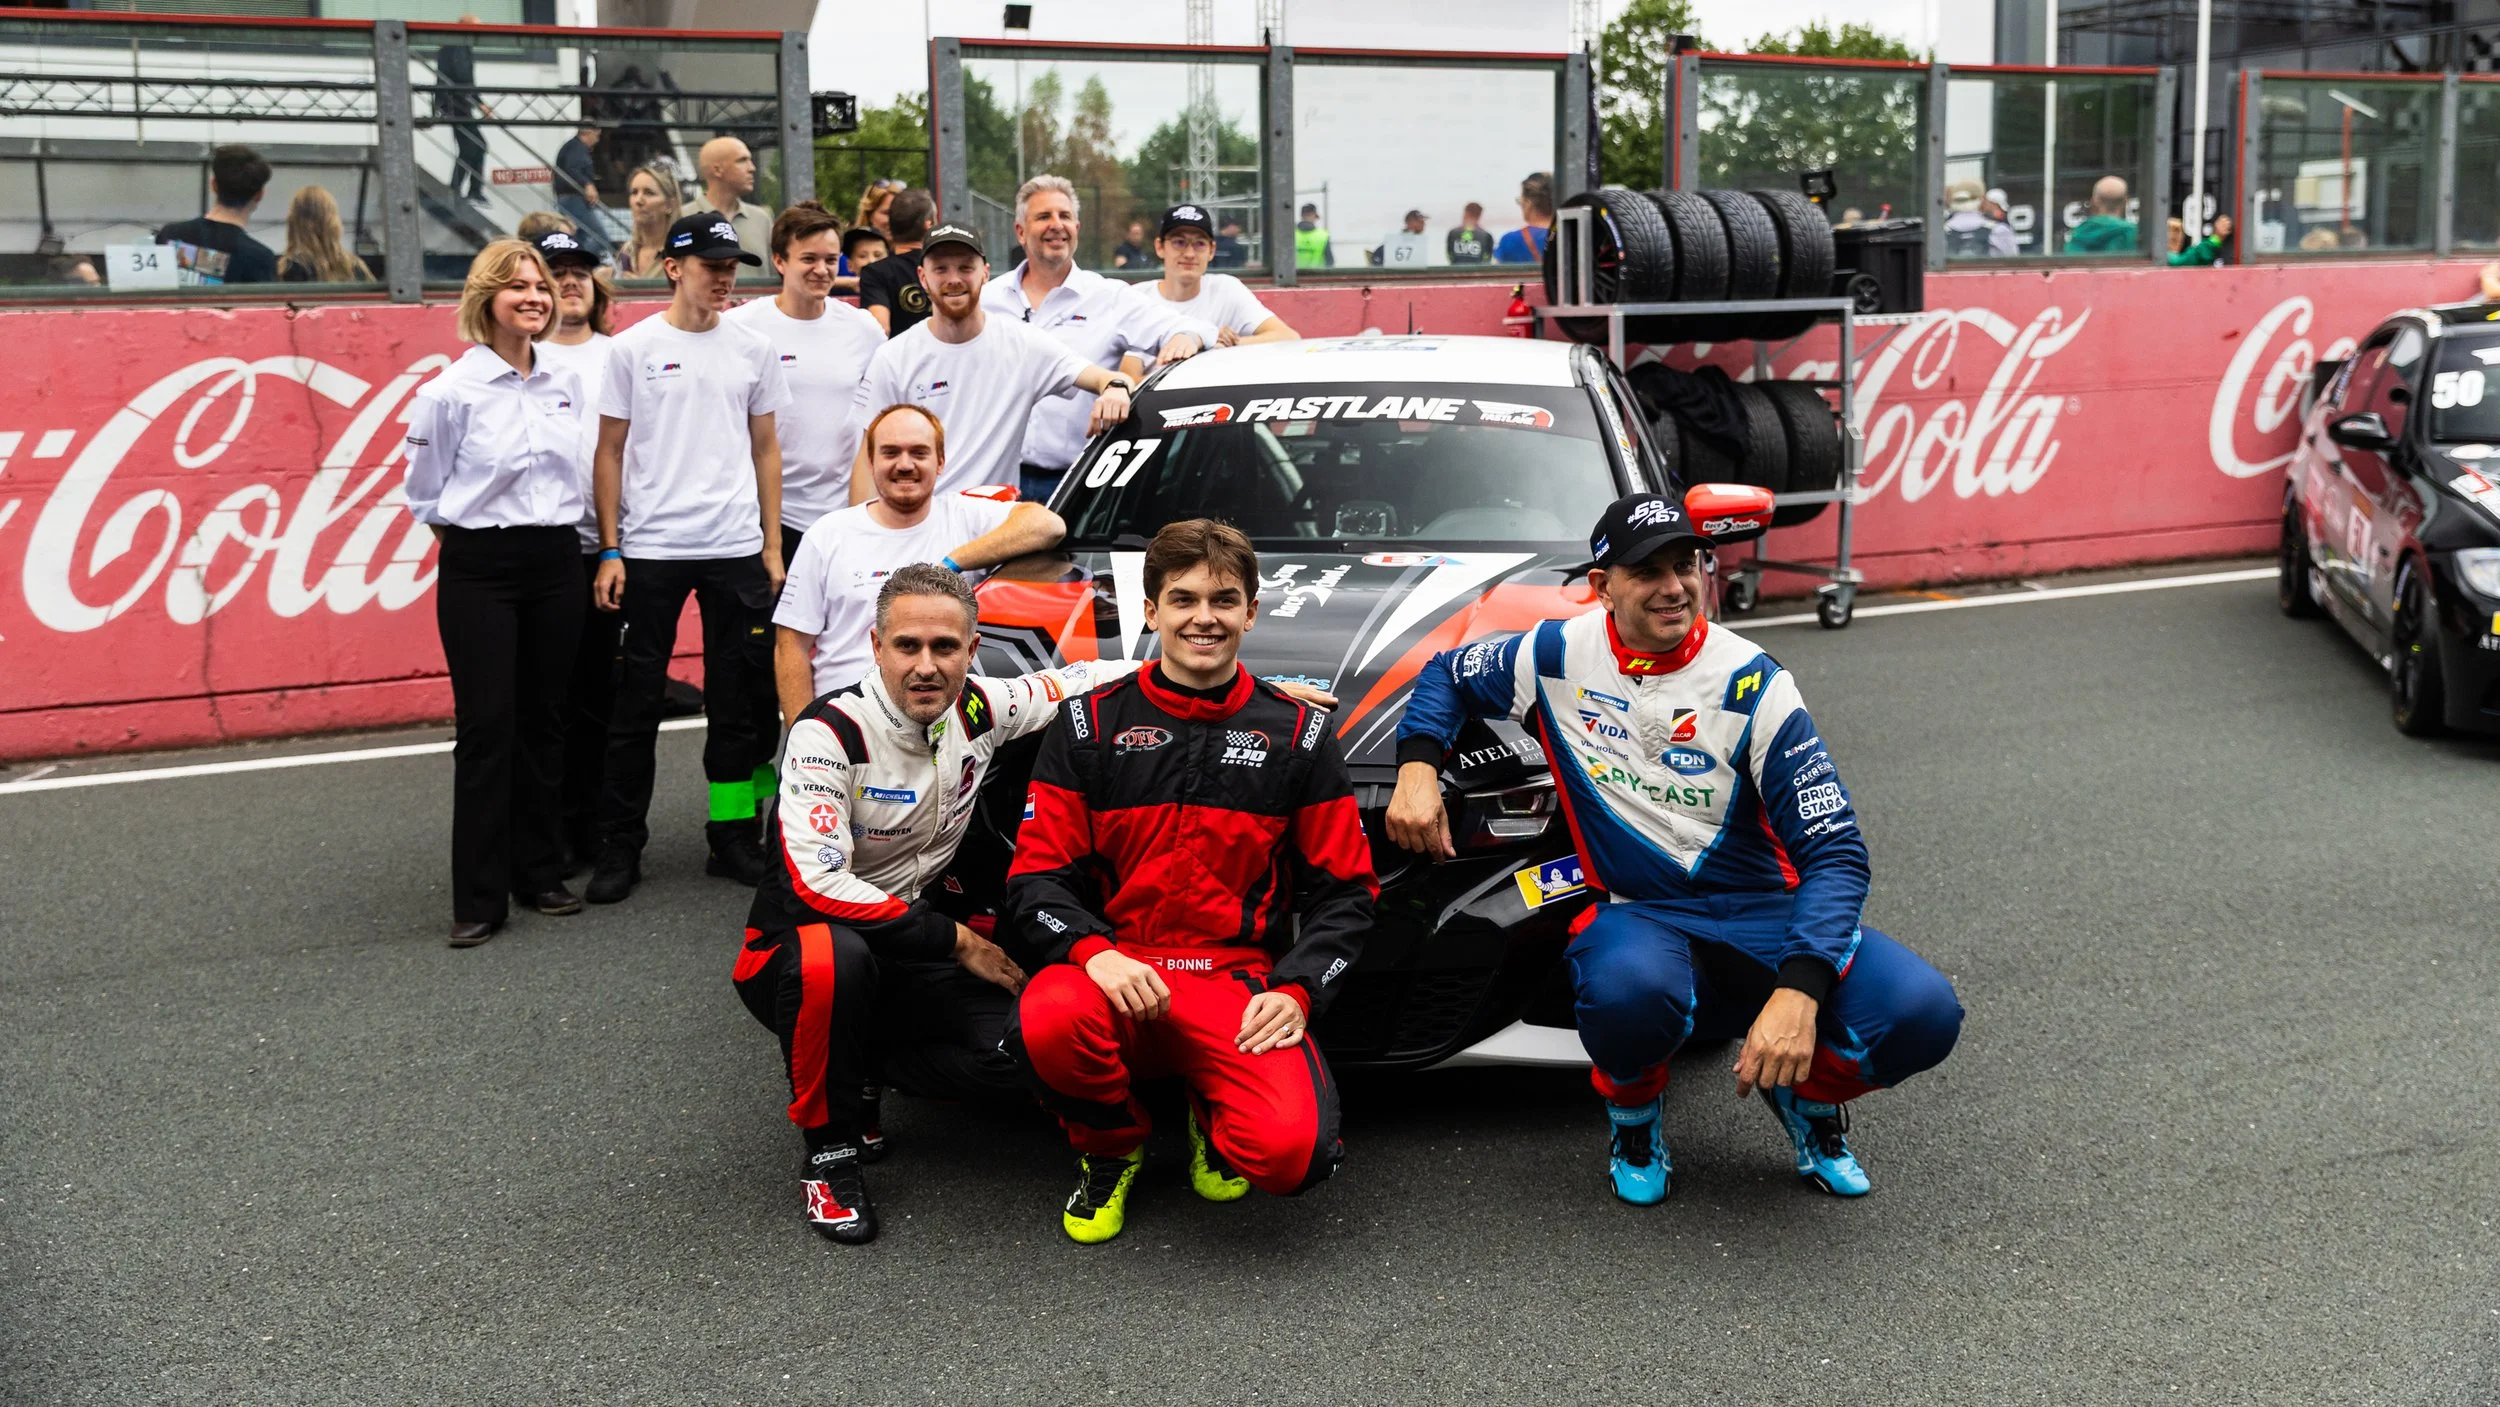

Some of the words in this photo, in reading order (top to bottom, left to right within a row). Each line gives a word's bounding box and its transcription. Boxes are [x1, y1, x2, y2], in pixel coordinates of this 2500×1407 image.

[131, 253, 159, 272] 34
[2431, 370, 2486, 409] 50
[1236, 396, 1466, 423] FASTLANE
[1480, 411, 1535, 426] FASTLANE
[1085, 439, 1162, 488] 67
[1592, 694, 1626, 708] MICHELIN
[1070, 699, 1089, 739] sparco
[1302, 711, 1325, 751] sparco
[1598, 723, 1629, 741] VDA
[1222, 746, 1267, 762] XJD
[1671, 753, 1706, 766] FDN
[801, 757, 847, 772] VERKOYEN
[1221, 759, 1262, 767] RACING
[803, 784, 845, 800] VERKOYEN
[874, 792, 911, 801] MICHELIN
[1800, 785, 1840, 804] BRICK
[1801, 799, 1834, 817] STAR
[867, 827, 912, 836] VERKOYEN
[1167, 959, 1212, 970] BONNE
